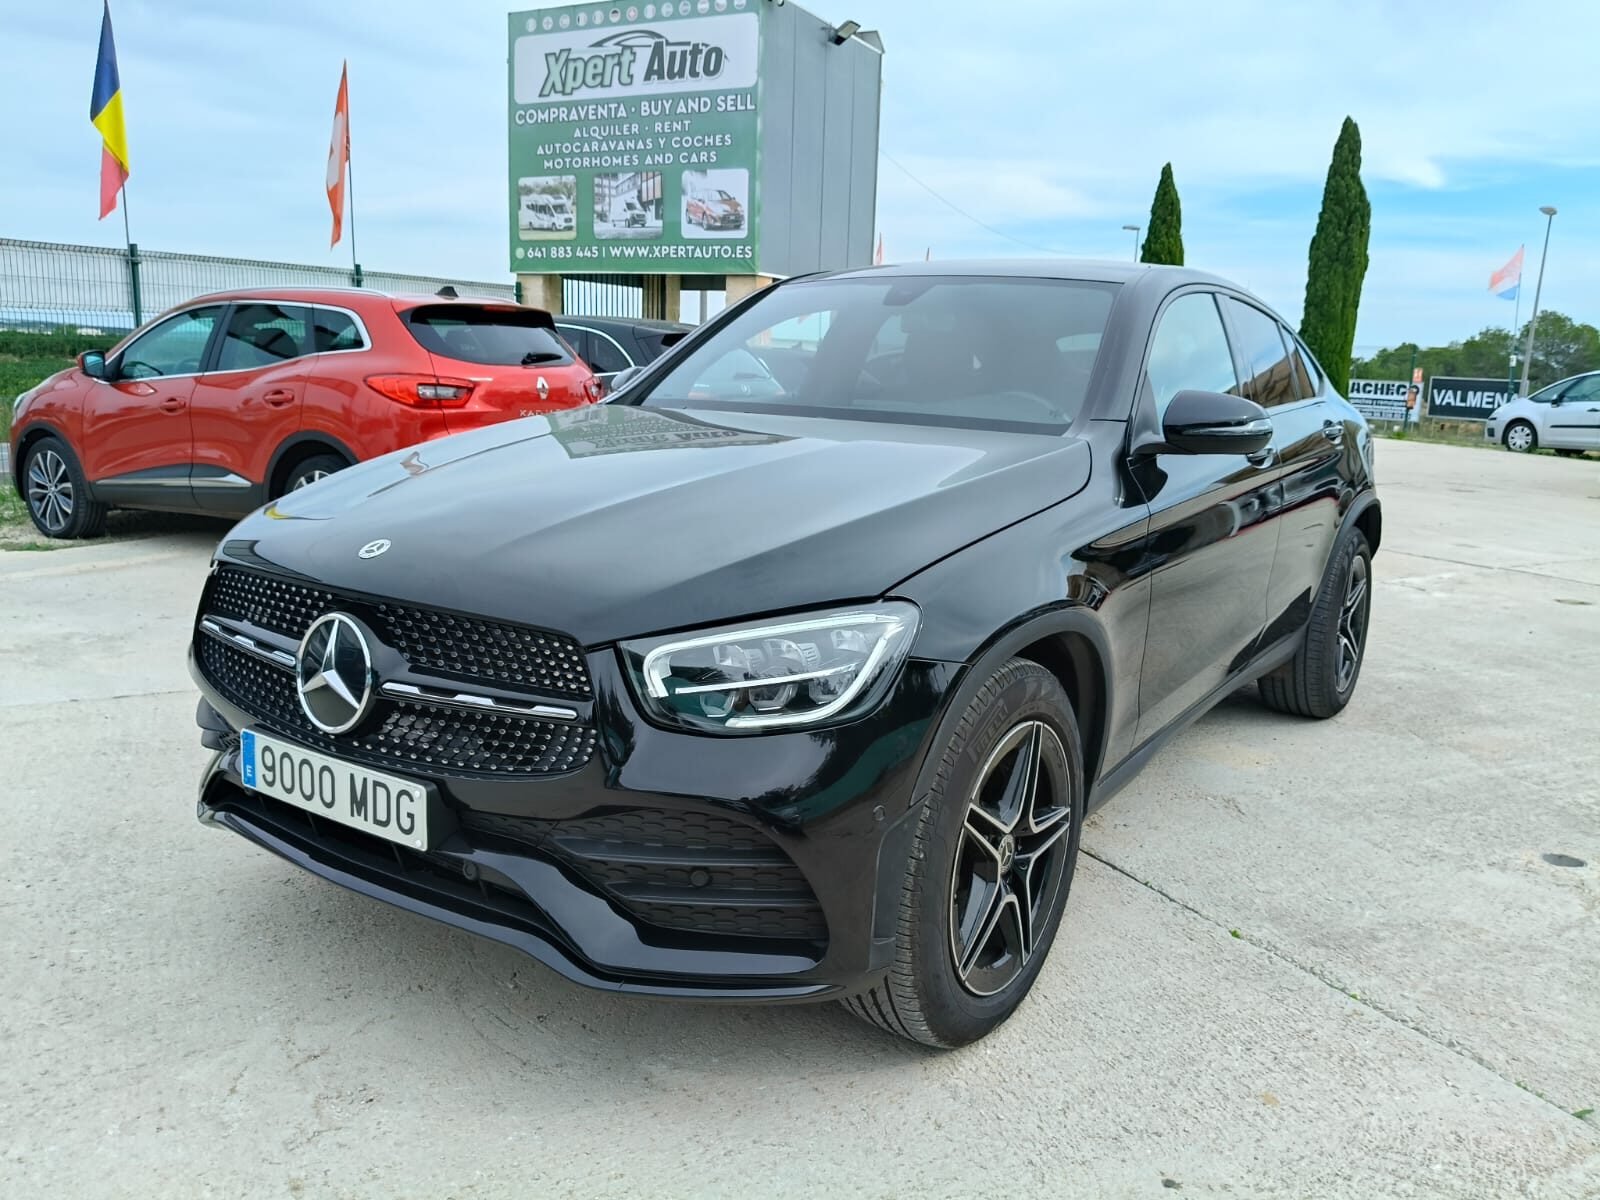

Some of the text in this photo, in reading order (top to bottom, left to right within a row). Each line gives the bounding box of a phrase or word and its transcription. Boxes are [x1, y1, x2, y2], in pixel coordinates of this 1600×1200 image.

[538, 40, 723, 97] Xpert Auto
[515, 94, 755, 124] COMPRAVENTA BUY AND SELL
[573, 120, 691, 140] ALQUILER RENT
[536, 134, 732, 155] AUTOCARAVANAS Y COCHES
[543, 151, 717, 169] MOTORHOMES AND CARS
[527, 246, 752, 258] 641 883 445 WWW.XPERTAUTO.ES
[246, 766, 253, 777] E
[261, 745, 415, 835] 9000 MDG
